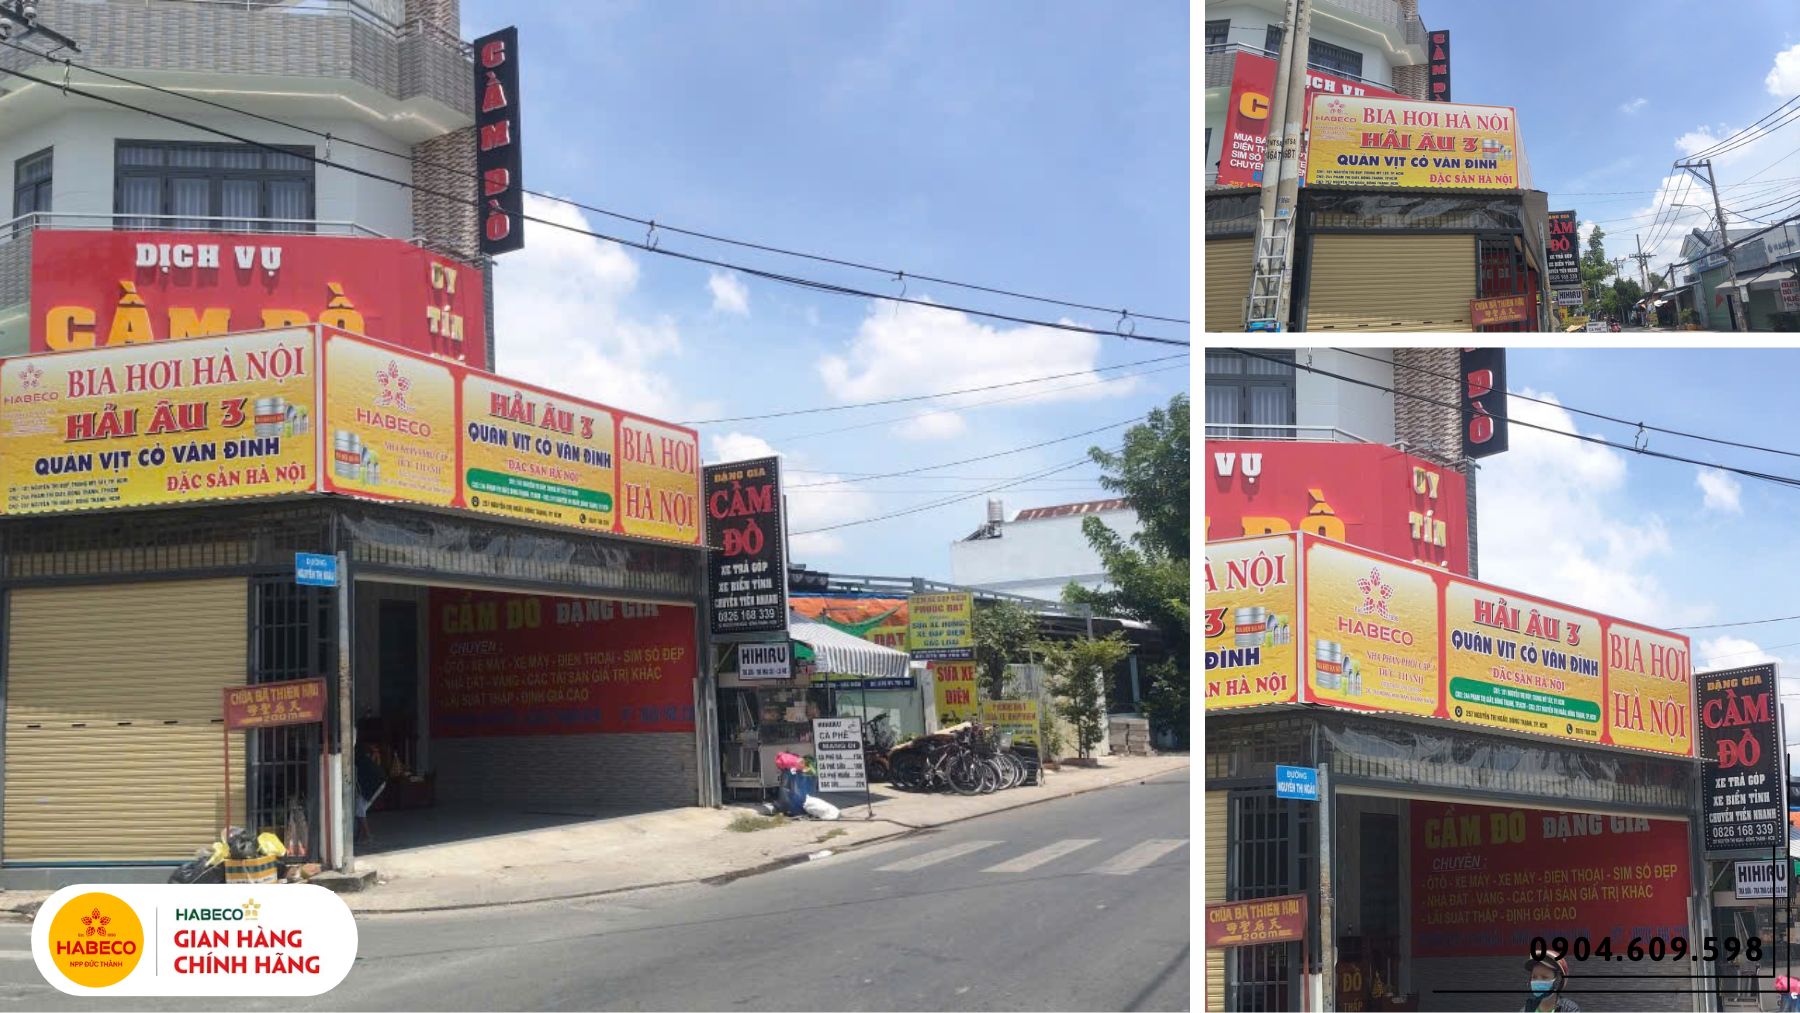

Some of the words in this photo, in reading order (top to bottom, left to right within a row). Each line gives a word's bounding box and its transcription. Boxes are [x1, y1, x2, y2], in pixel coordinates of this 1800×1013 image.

[1363, 107, 1397, 125] BIA
[1403, 109, 1439, 127] HƠI
[1445, 110, 1473, 129] HÀ
[1477, 113, 1509, 133] NỘI
[1233, 132, 1253, 142] MUA
[1233, 141, 1253, 152] ĐIỆN
[1360, 128, 1411, 150] HẢI
[1415, 132, 1455, 151] ÂU
[1462, 137, 1478, 152] 3
[1232, 150, 1247, 159] SIM
[1337, 152, 1379, 166] QUÁN
[1384, 156, 1406, 169] VỊT
[1410, 153, 1429, 168] CỎ
[1433, 155, 1460, 168] VÂN
[1464, 155, 1497, 169] ĐÌNH
[1429, 172, 1452, 185] ĐẶC
[1454, 172, 1475, 184] SẢN
[1478, 173, 1493, 184] HÀ
[1495, 172, 1513, 185] NỘI
[136, 243, 220, 273] DỊCH
[234, 246, 282, 277] VỤ
[67, 366, 117, 398] BIA
[125, 358, 183, 393] HƠI
[191, 346, 237, 385] HÀ
[246, 342, 305, 383] NỘI
[4, 391, 58, 405] HABECO
[64, 403, 138, 441] HẢI
[144, 400, 208, 435] ÂU
[220, 398, 248, 427] 3
[356, 407, 432, 437] HABECO
[489, 391, 536, 426] HẢI
[539, 402, 574, 435] ÂU
[580, 415, 594, 439] 3
[35, 453, 92, 476] QUÁN
[99, 450, 132, 473] VỊT
[138, 443, 165, 467] CỎ
[172, 440, 216, 463] VÂN
[223, 437, 279, 458] ĐÌNH
[468, 421, 508, 446] QUÁN
[512, 431, 531, 454] VỊT
[535, 434, 552, 456] CỎ
[556, 441, 580, 462] VÂN
[583, 447, 611, 469] ĐÌNH
[622, 426, 656, 466] BIA
[660, 434, 696, 475] HƠI
[167, 470, 201, 493] ĐẶC
[206, 465, 241, 487] SẢN
[245, 464, 269, 484] HÀ
[276, 461, 306, 481] NỘI
[1214, 452, 1263, 485] VỤ
[624, 482, 656, 521] HÀ
[658, 487, 695, 532] NỘI
[1409, 509, 1446, 548] TÍN
[1226, 551, 1287, 592] NỘI
[1205, 607, 1228, 638] 3
[1337, 616, 1414, 646] HABECO
[1473, 597, 1520, 633] HẢI
[1525, 608, 1561, 644] ÂU
[1567, 620, 1583, 647] 3
[741, 647, 786, 665] HIHIRU
[1452, 629, 1493, 656] QUÁN
[1496, 638, 1517, 662] VỊT
[1520, 642, 1538, 664] CỎ
[1542, 650, 1567, 671] VÂN
[1570, 654, 1600, 677] ĐÌNH
[1608, 632, 1646, 672] BIA
[1650, 642, 1689, 684] HƠI
[1226, 674, 1251, 696] HÀ
[1255, 671, 1287, 696] NỘI
[1492, 666, 1513, 682] ĐẶC
[1514, 669, 1533, 685] SẢN
[1535, 672, 1547, 687] HÀ
[1549, 676, 1566, 693] NỘI
[1742, 675, 1762, 687] GIA
[1613, 688, 1645, 731] HÀ
[1649, 694, 1686, 744] NỘI
[1715, 777, 1726, 789] XE
[1728, 772, 1745, 787] TRẢ
[1747, 771, 1766, 786] GÓP
[1713, 795, 1724, 807] XE
[1725, 790, 1747, 805] BIỂN
[1749, 788, 1770, 803] TỈNH
[1735, 806, 1752, 822] TIỀN
[1753, 808, 1777, 820] NHANH
[1712, 825, 1735, 838] 0826
[1737, 824, 1754, 836] 168
[1756, 823, 1773, 835] 339
[1613, 866, 1632, 880] SIM
[1654, 864, 1678, 881] ĐẸP
[1601, 885, 1619, 902] TRỊ
[1622, 882, 1654, 899] KHÁC
[1209, 907, 1232, 923] CHÙA
[1553, 906, 1577, 920] CAO
